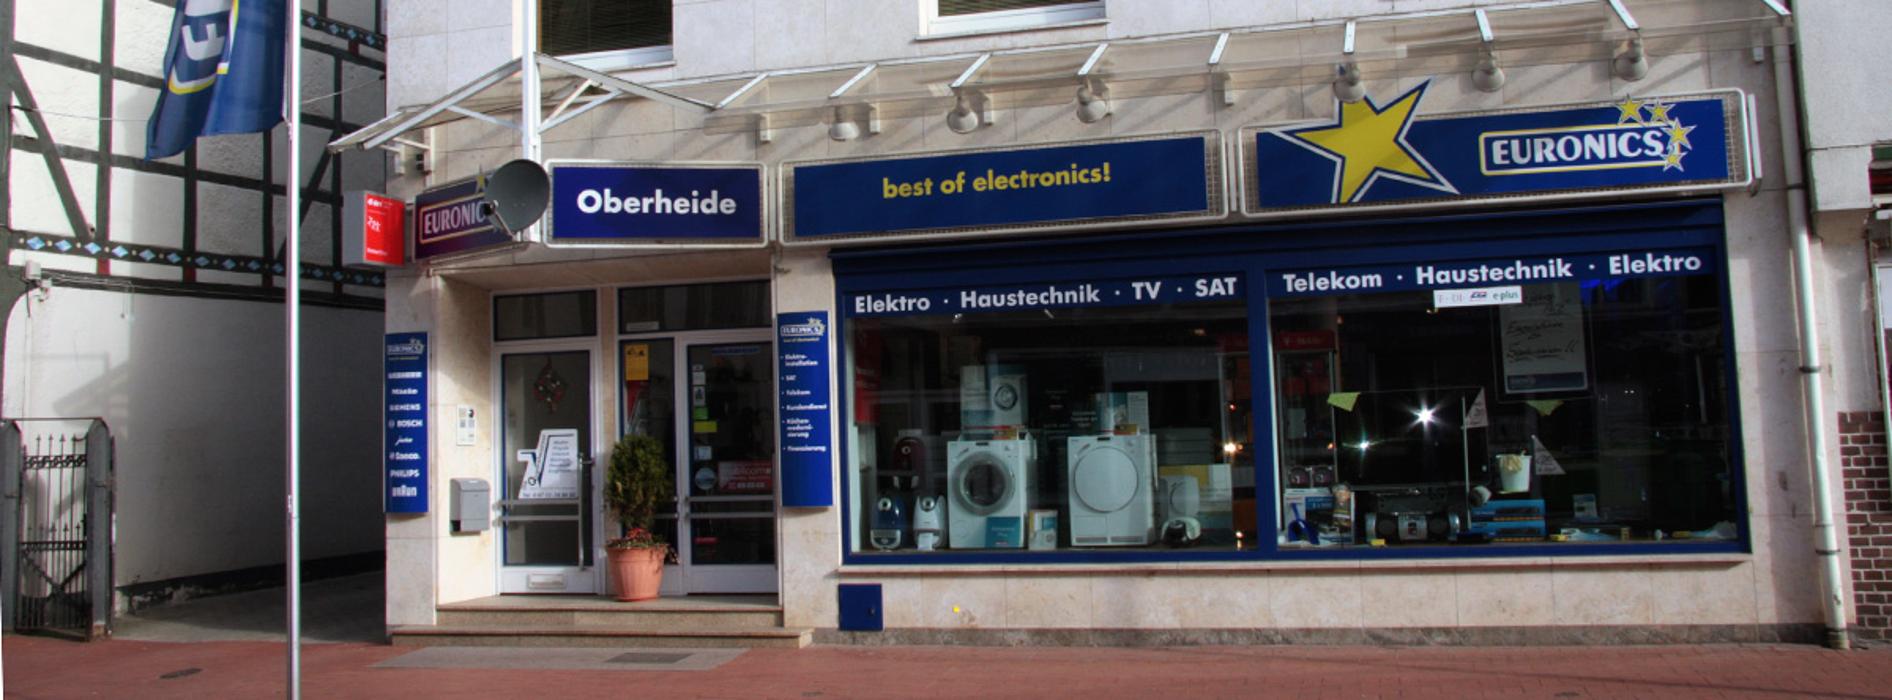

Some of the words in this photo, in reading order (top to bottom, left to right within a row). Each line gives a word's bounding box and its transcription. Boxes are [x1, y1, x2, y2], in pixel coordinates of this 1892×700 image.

[1492, 131, 1663, 165] EURONICS
[883, 177, 933, 198] best
[940, 171, 965, 194] of
[972, 162, 1111, 191] electronics!
[424, 200, 486, 234] EURONIC
[577, 188, 737, 214] Oberheide
[1283, 272, 1382, 292] Telekom
[1416, 259, 1573, 285] Haustechnik
[1609, 253, 1701, 275] Elektro
[855, 295, 930, 313] Elektro
[961, 284, 1100, 308] Haustechnik
[1132, 282, 1161, 299] TV
[1195, 277, 1237, 297] SAT
